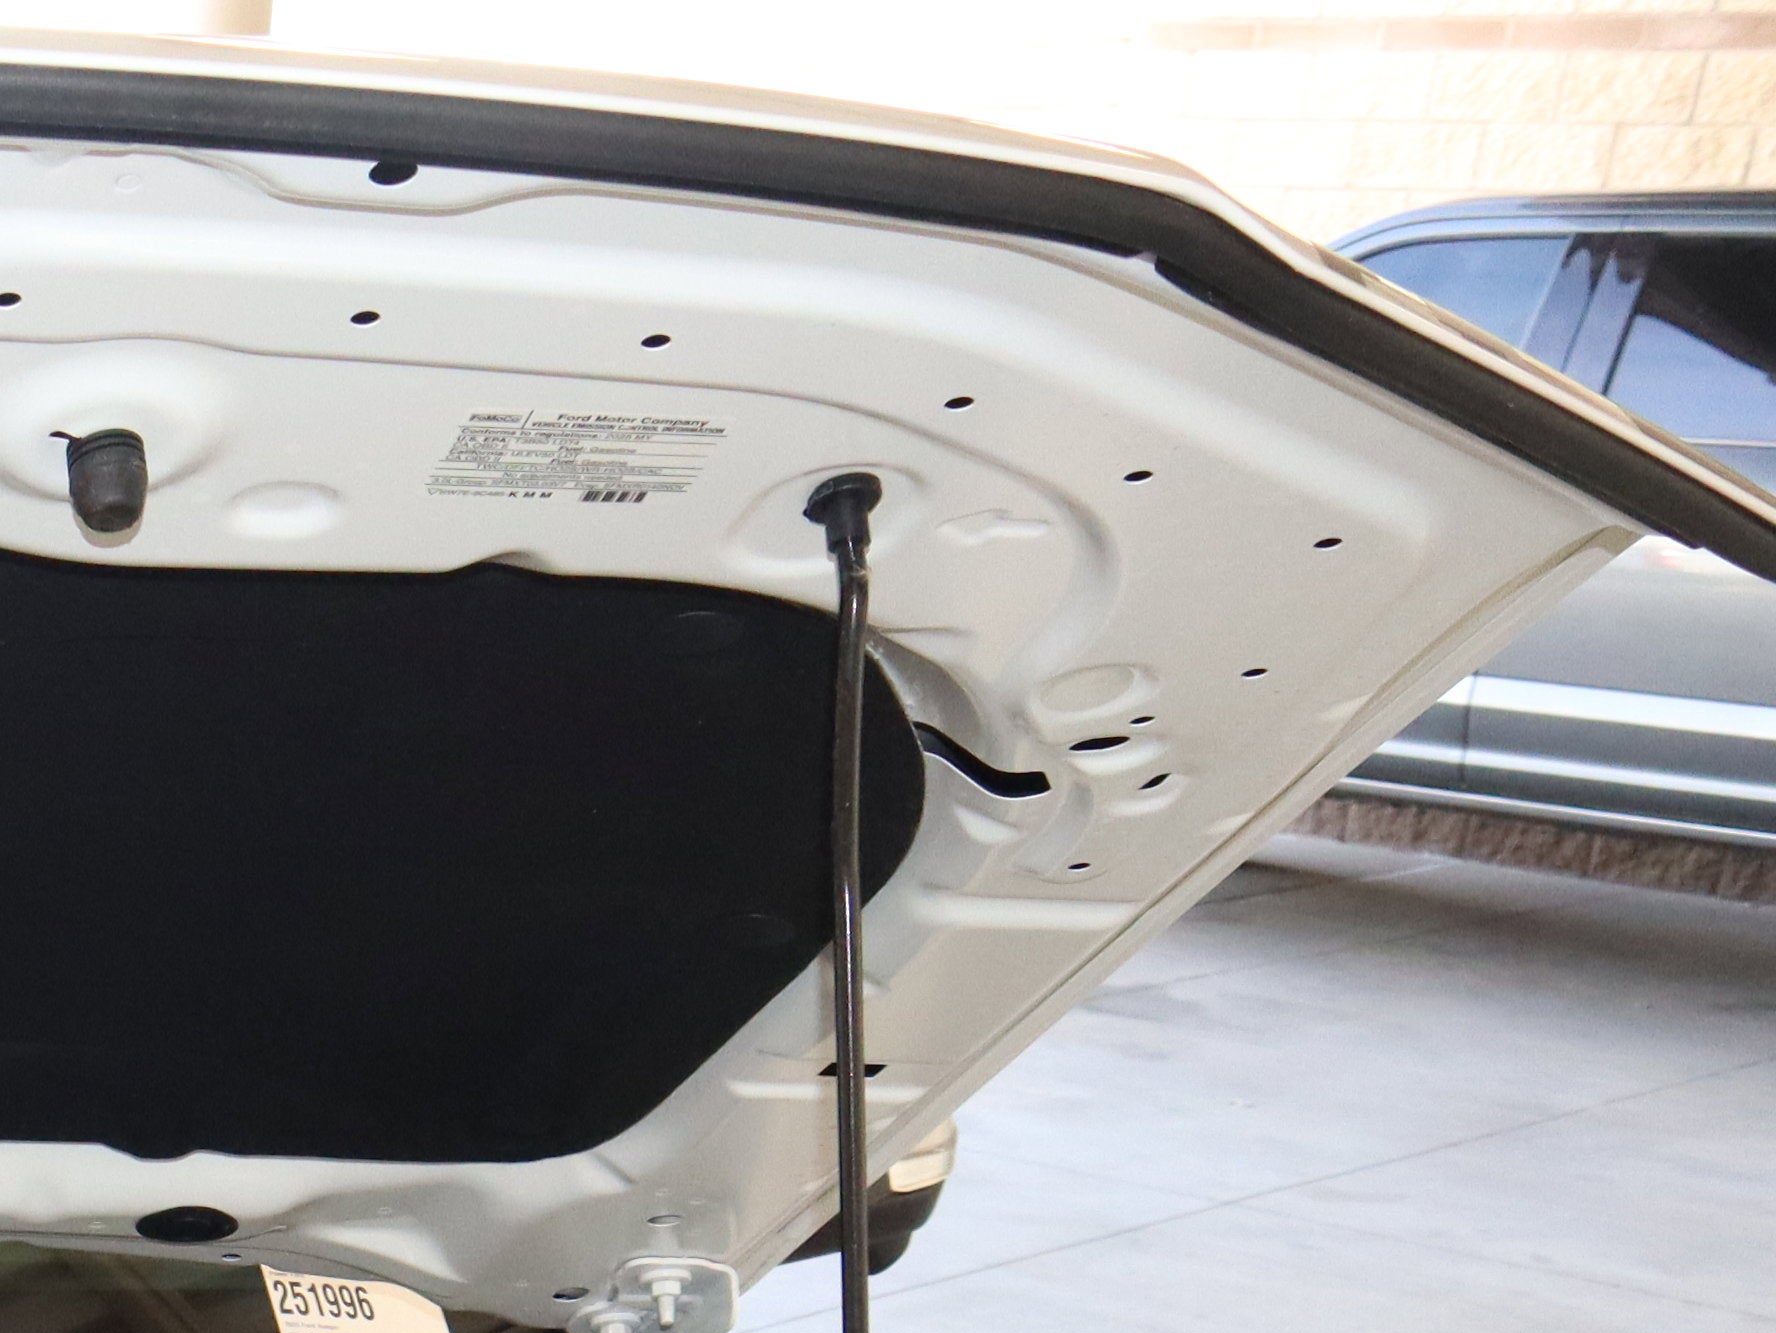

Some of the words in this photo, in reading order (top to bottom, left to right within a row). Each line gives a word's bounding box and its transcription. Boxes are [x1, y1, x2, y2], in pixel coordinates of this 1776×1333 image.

[469, 414, 523, 423] FoMoCo
[557, 414, 592, 422] Ford
[595, 415, 637, 424] Motor
[640, 416, 710, 427] Company
[661, 426, 725, 434] INFORMATION
[273, 1281, 375, 1320] 251996
